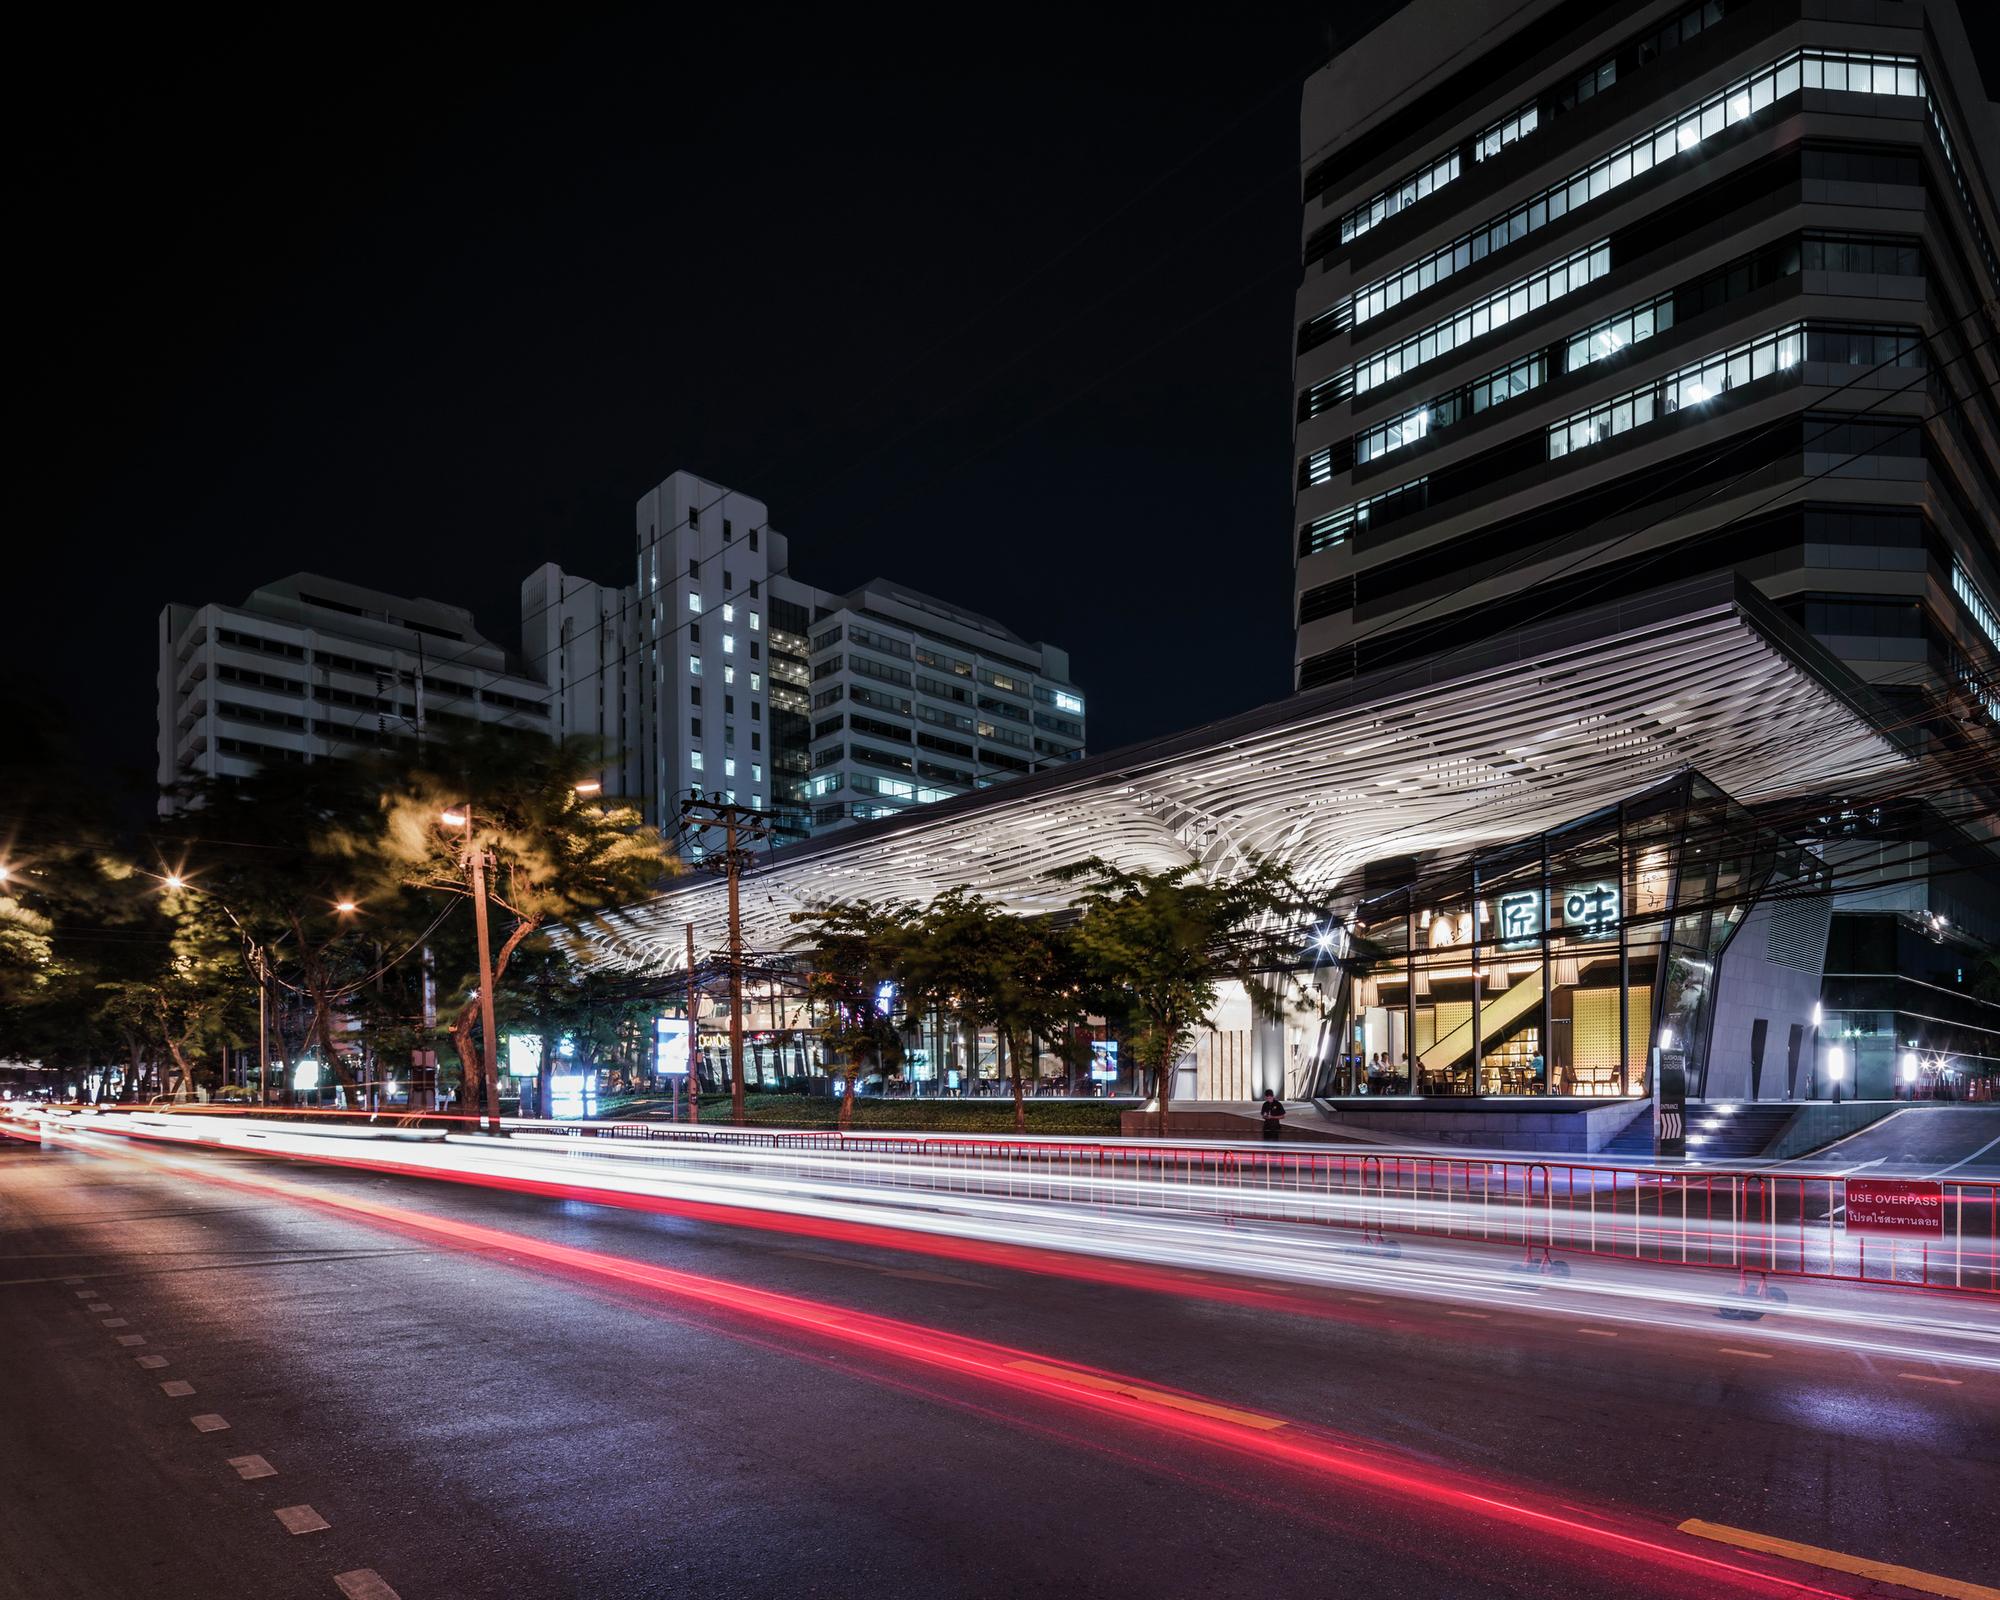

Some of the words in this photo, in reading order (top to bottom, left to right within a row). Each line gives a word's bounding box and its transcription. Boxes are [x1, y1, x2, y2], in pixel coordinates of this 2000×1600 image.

[1850, 1193, 1872, 1203] USE
[1875, 1194, 1938, 1206] OVERPASS
[1848, 1210, 1939, 1226] โปรดใช้สะพานลอย
